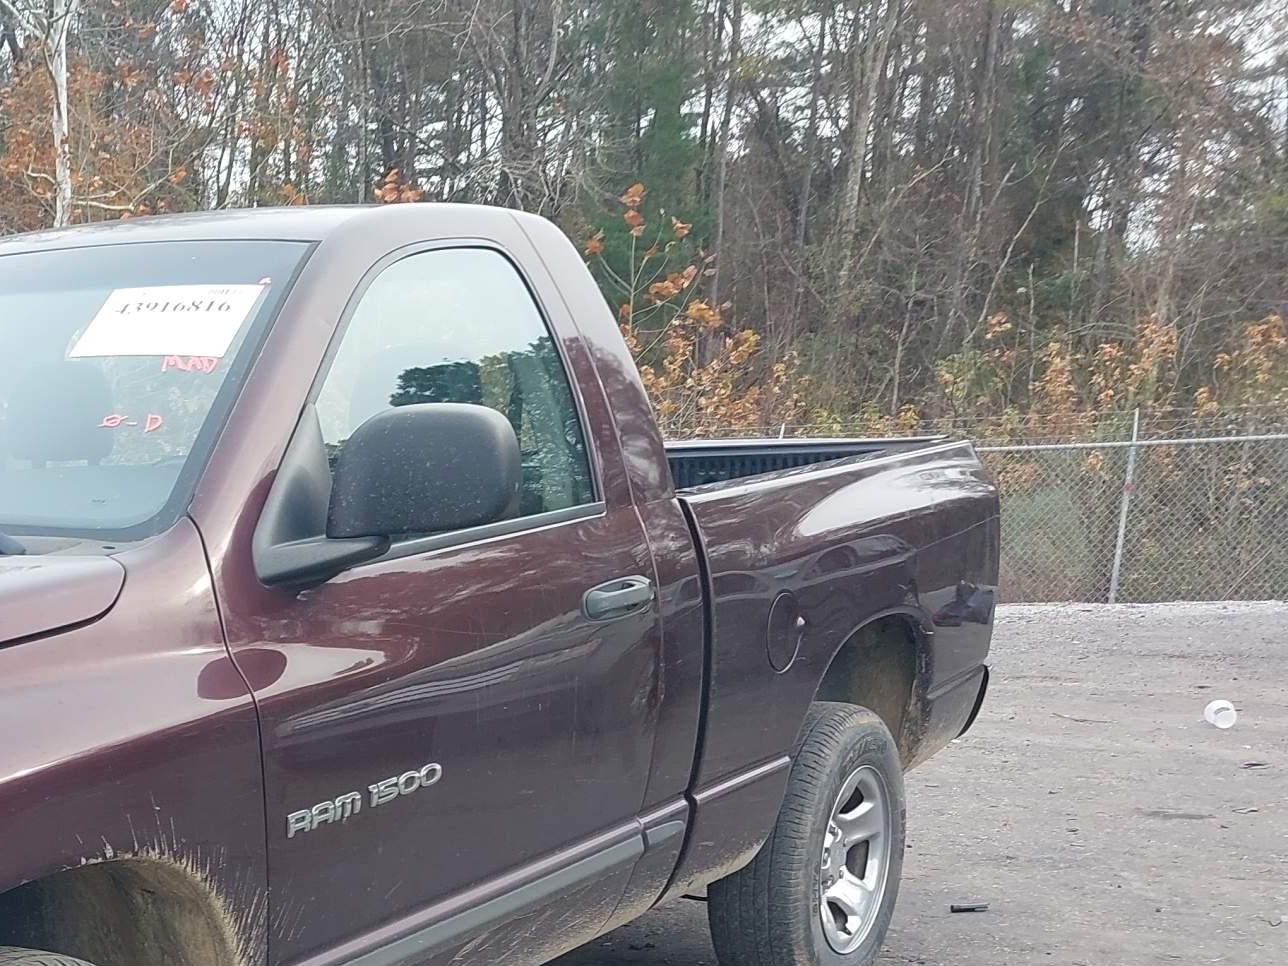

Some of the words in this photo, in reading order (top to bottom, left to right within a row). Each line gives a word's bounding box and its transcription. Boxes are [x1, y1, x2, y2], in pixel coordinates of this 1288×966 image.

[114, 300, 231, 315] 43916816
[286, 791, 362, 838] RAM
[367, 762, 442, 808] 1500
